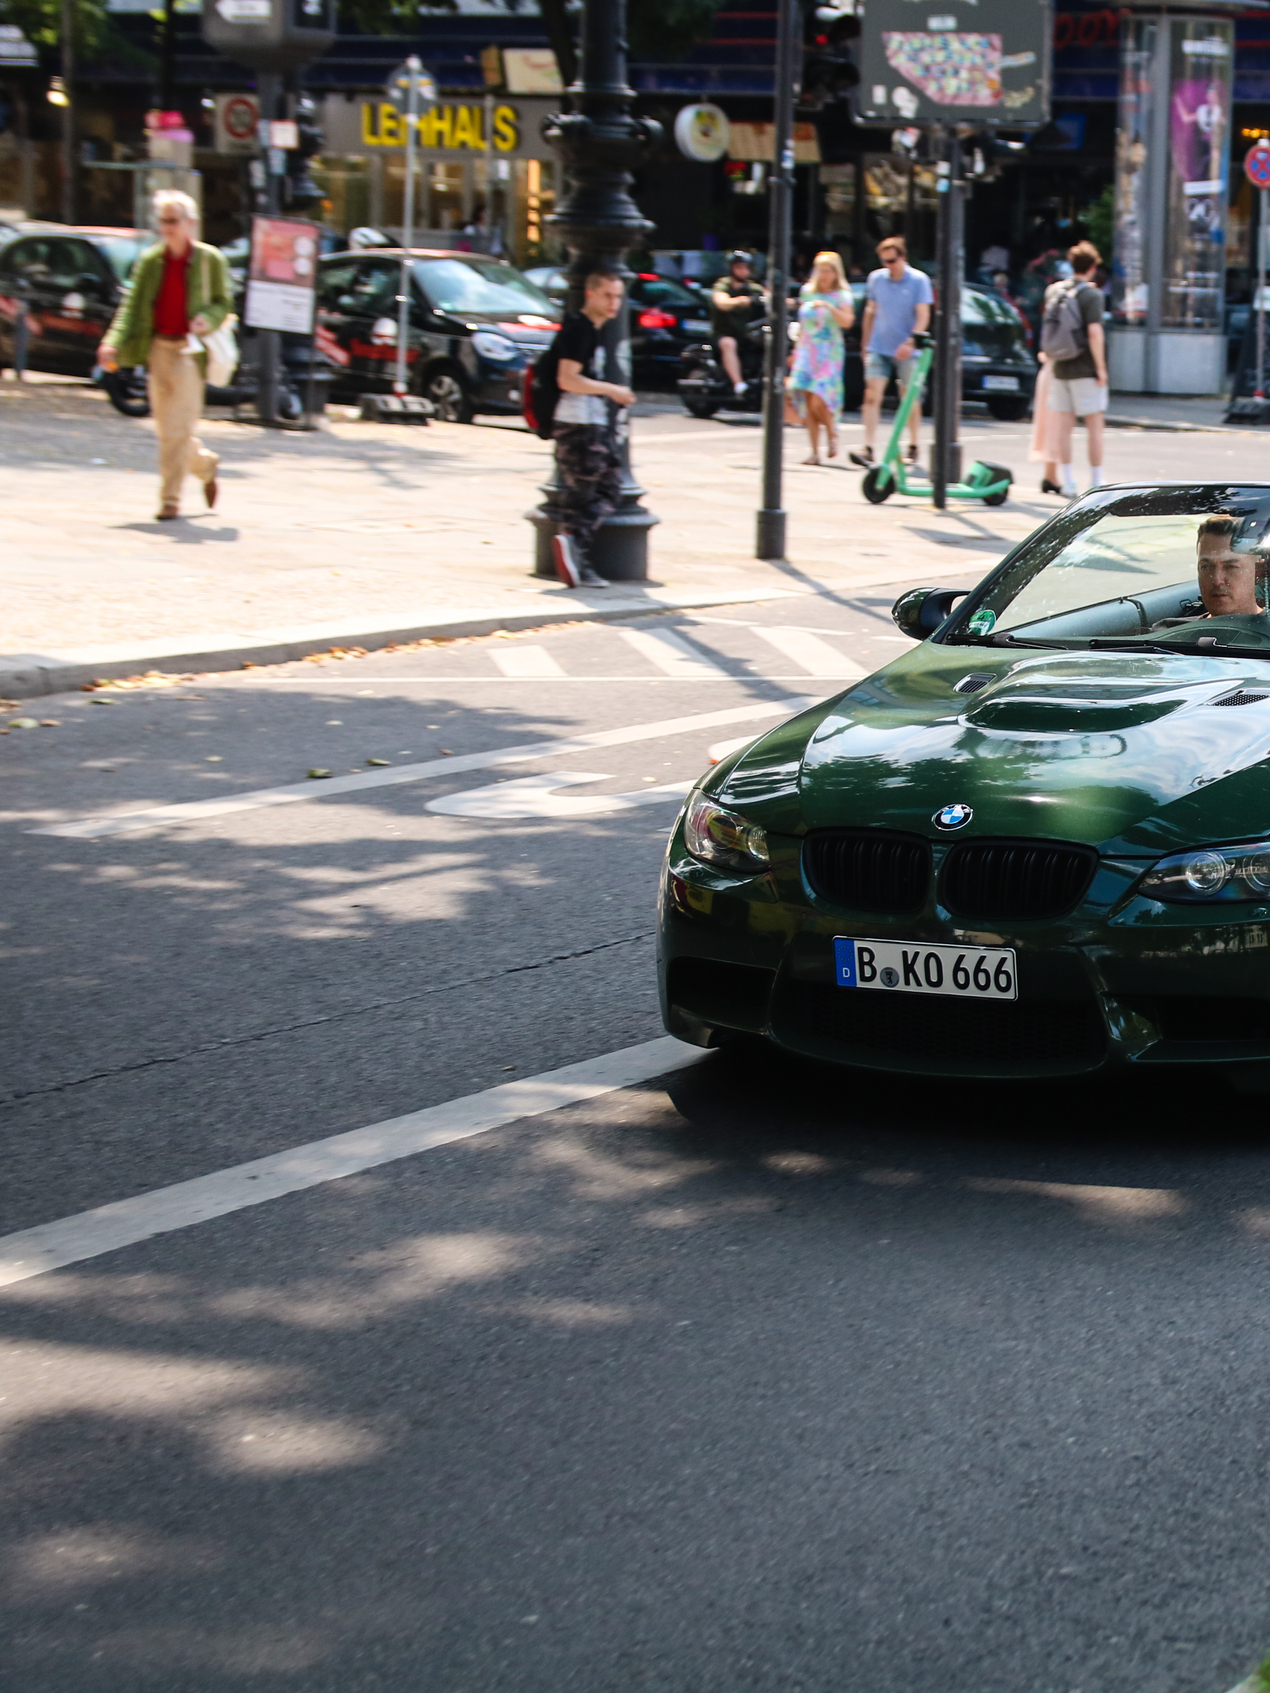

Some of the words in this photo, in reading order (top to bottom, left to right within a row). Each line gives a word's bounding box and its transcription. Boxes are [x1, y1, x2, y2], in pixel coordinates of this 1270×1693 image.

[842, 967, 850, 978] D
[857, 946, 877, 983] B
[902, 950, 943, 988] KO
[952, 954, 1012, 993] 666
